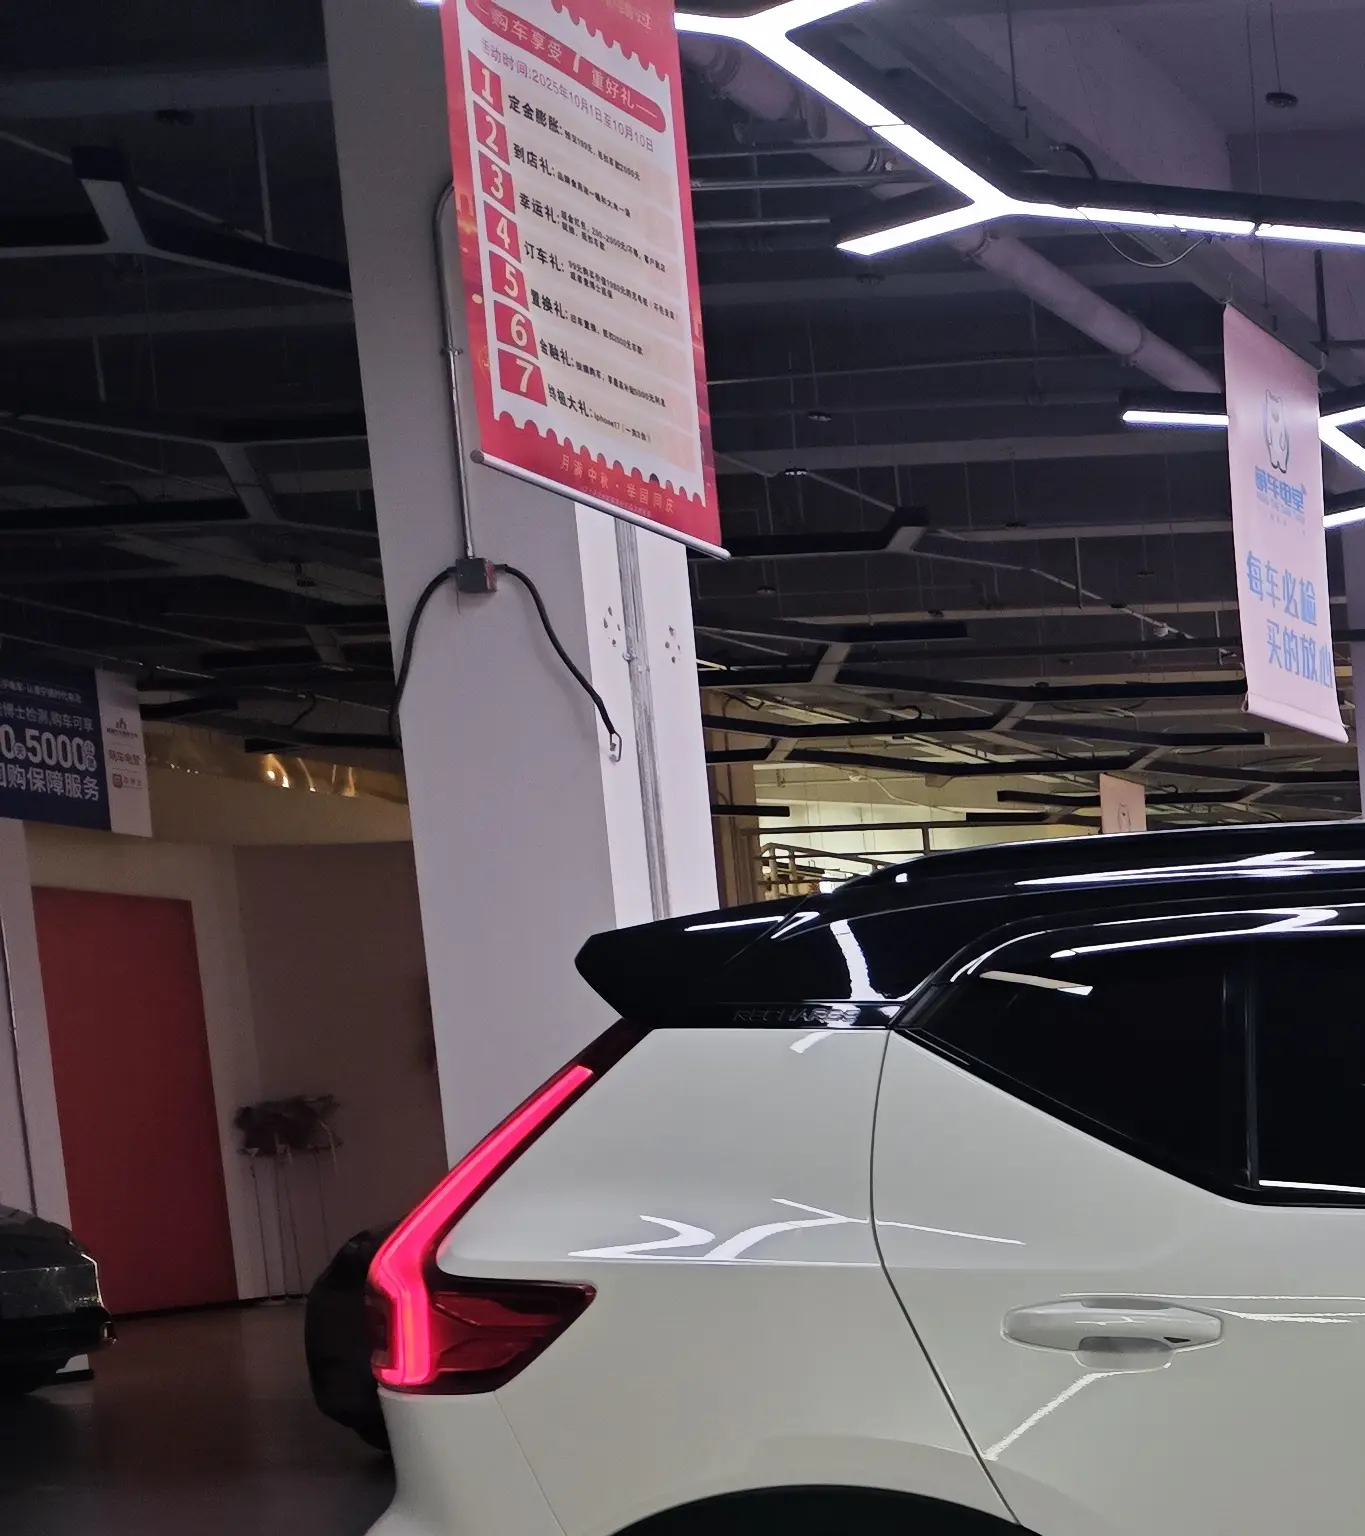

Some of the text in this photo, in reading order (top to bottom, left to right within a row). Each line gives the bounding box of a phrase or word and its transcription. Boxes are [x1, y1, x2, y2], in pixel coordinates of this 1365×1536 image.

[478, 64, 493, 105] 1
[484, 113, 499, 153] 2
[488, 162, 504, 202] 3
[495, 213, 510, 251] 4
[502, 261, 518, 300] 5
[509, 309, 527, 349] 6
[515, 357, 536, 398] 7
[1246, 550, 1316, 626] 每车必检
[1266, 619, 1334, 689] 买的放心
